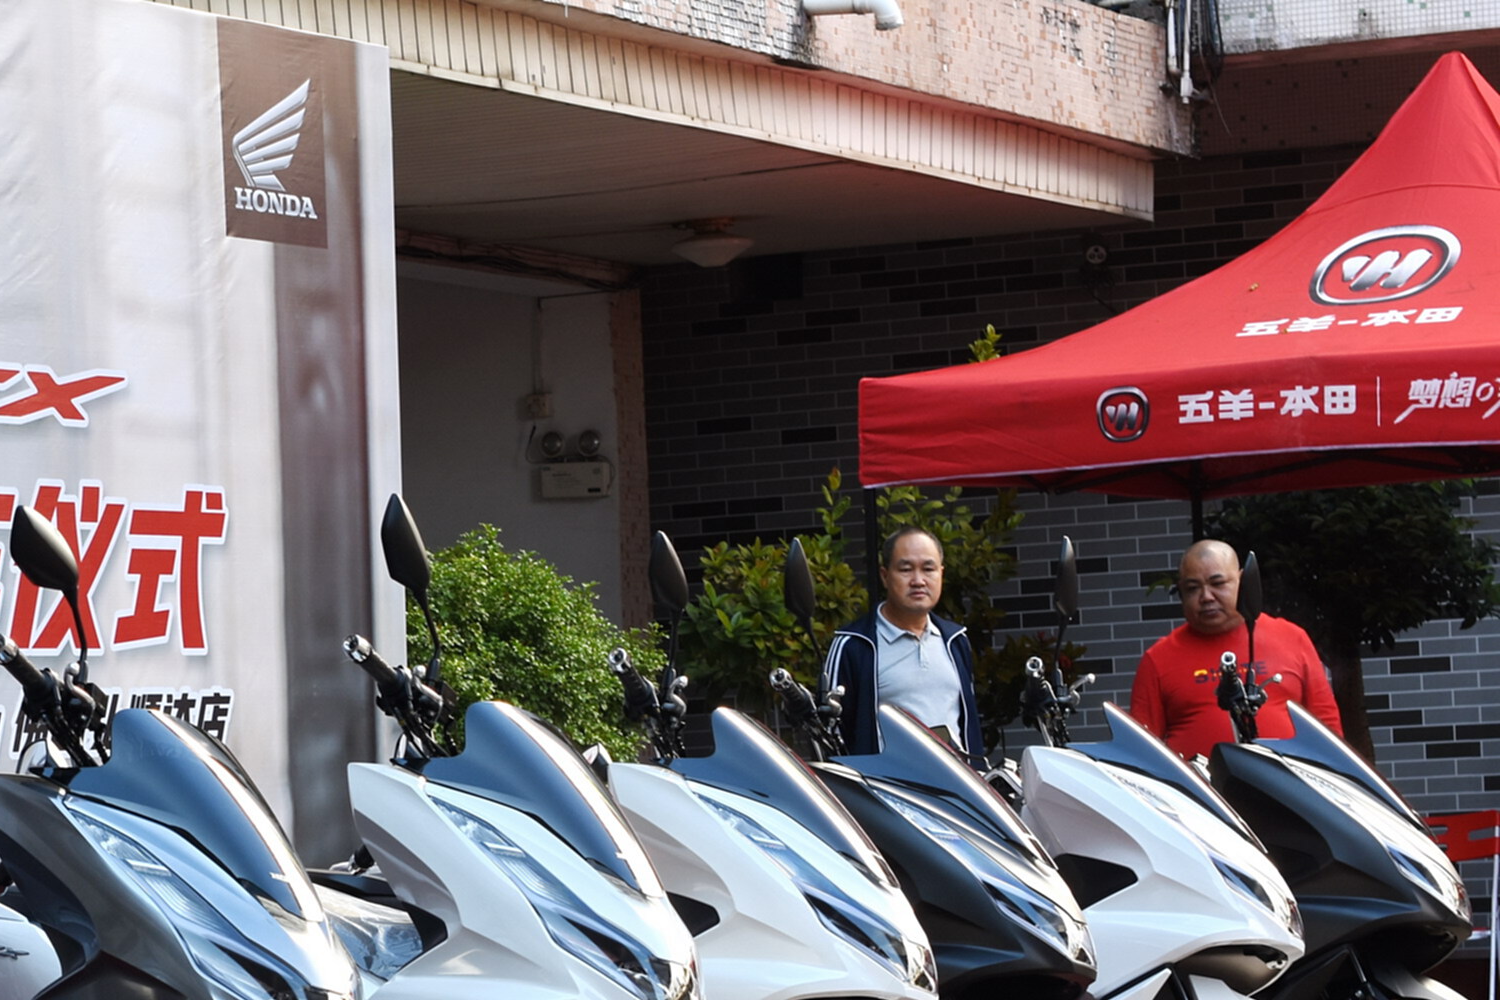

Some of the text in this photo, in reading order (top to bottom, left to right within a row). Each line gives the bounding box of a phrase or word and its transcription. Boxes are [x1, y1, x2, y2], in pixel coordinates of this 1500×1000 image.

[234, 187, 318, 219] HONDA
[1235, 306, 1463, 337] 五羊-本田
[1178, 385, 1356, 424] 五羊-本田
